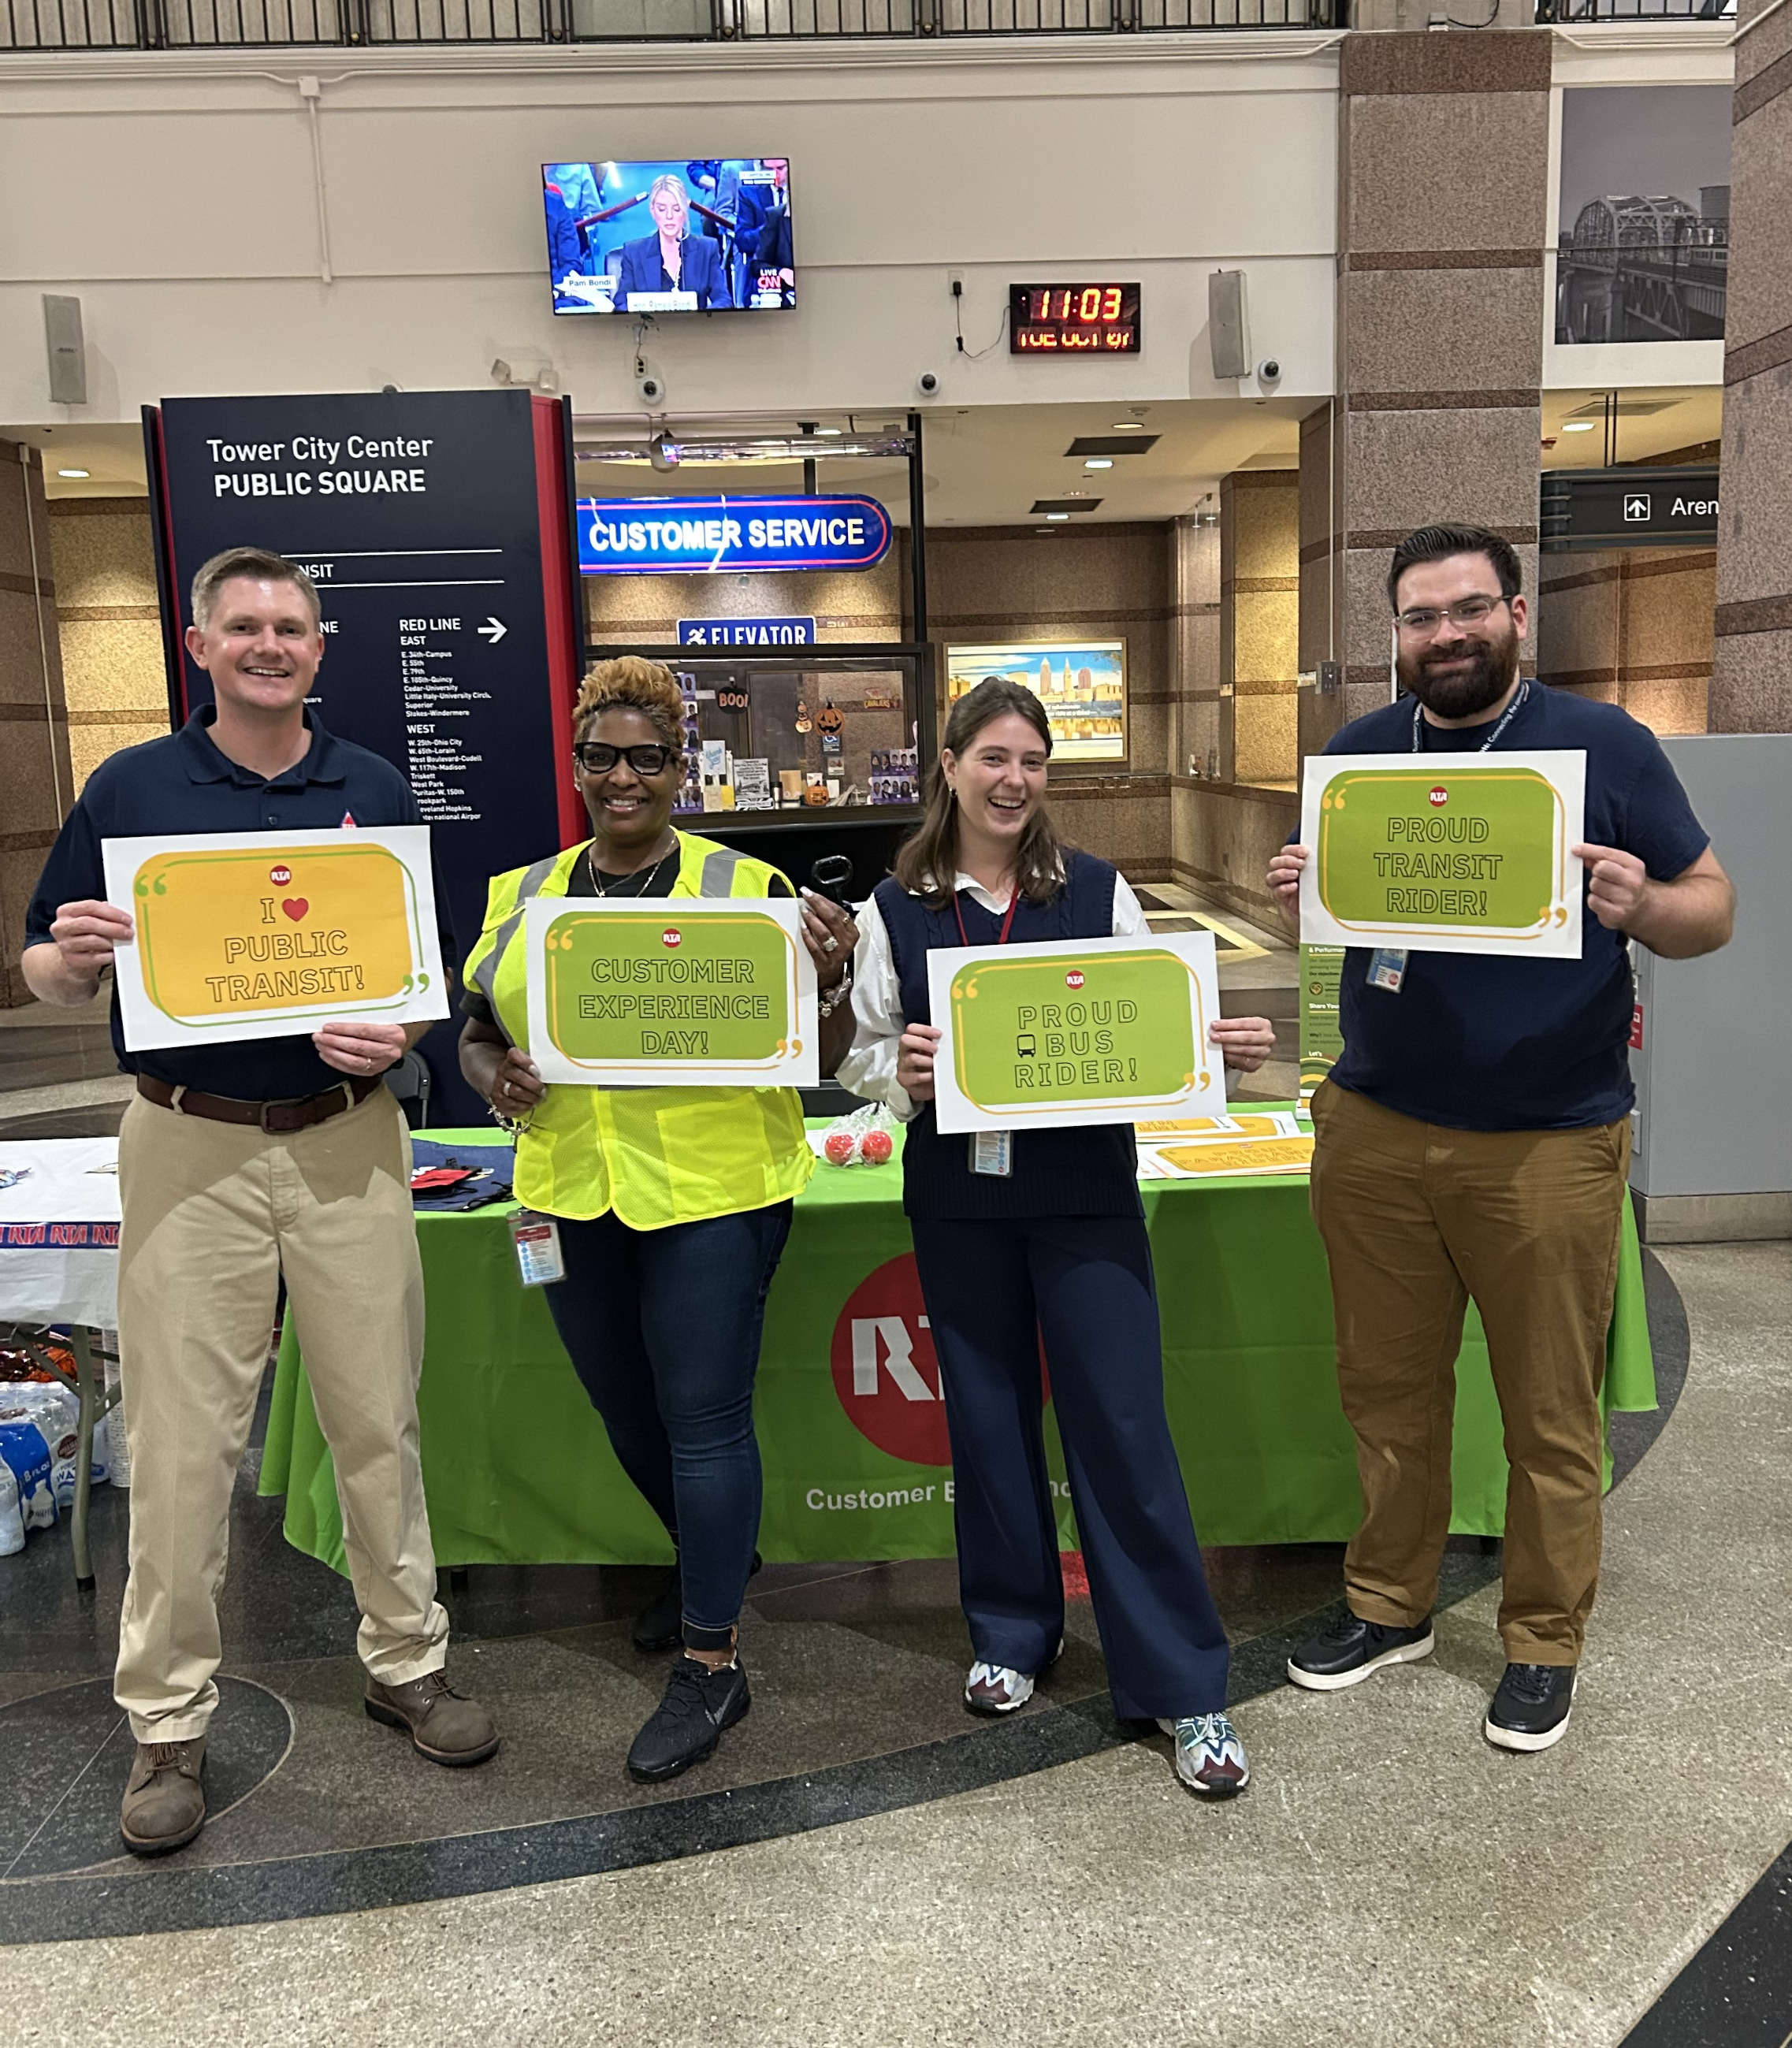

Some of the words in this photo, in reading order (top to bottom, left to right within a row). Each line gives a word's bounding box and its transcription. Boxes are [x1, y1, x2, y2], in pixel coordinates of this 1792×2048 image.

[757, 276, 781, 288] CNN
[1041, 288, 1122, 320] 11:03
[206, 439, 285, 463] Tower
[292, 437, 340, 465] City
[347, 435, 434, 459] Center
[214, 472, 312, 497] PUBLIC
[318, 469, 426, 494] SQUARE
[1671, 497, 1720, 516] Aren
[589, 520, 743, 551] CUSTOMER
[748, 519, 865, 547] SERVICE
[299, 563, 334, 578] NSIT
[319, 620, 339, 634] NE
[400, 619, 427, 631] RED
[429, 618, 462, 630] LINE
[400, 636, 426, 645] EAST
[407, 724, 436, 734] WEST
[1487, 713, 1513, 742] Connecting
[1387, 817, 1489, 843] PROUD
[1374, 852, 1503, 880] TRANSIT
[260, 898, 276, 924] I
[1386, 887, 1488, 916] RIDER!
[225, 930, 348, 964] PUBLIC
[205, 965, 366, 1002] TRANSIT!
[591, 958, 754, 983] CUSTOMER
[578, 994, 769, 1020] EXPERIENCE
[1018, 999, 1138, 1030] PROUD
[641, 1031, 709, 1055] DAY!
[1046, 1030, 1113, 1057] BUS
[1014, 1057, 1139, 1088] RIDER!
[50, 1225, 87, 1244] RTA
[92, 1225, 119, 1244] RT
[805, 1484, 936, 1510] Customer
